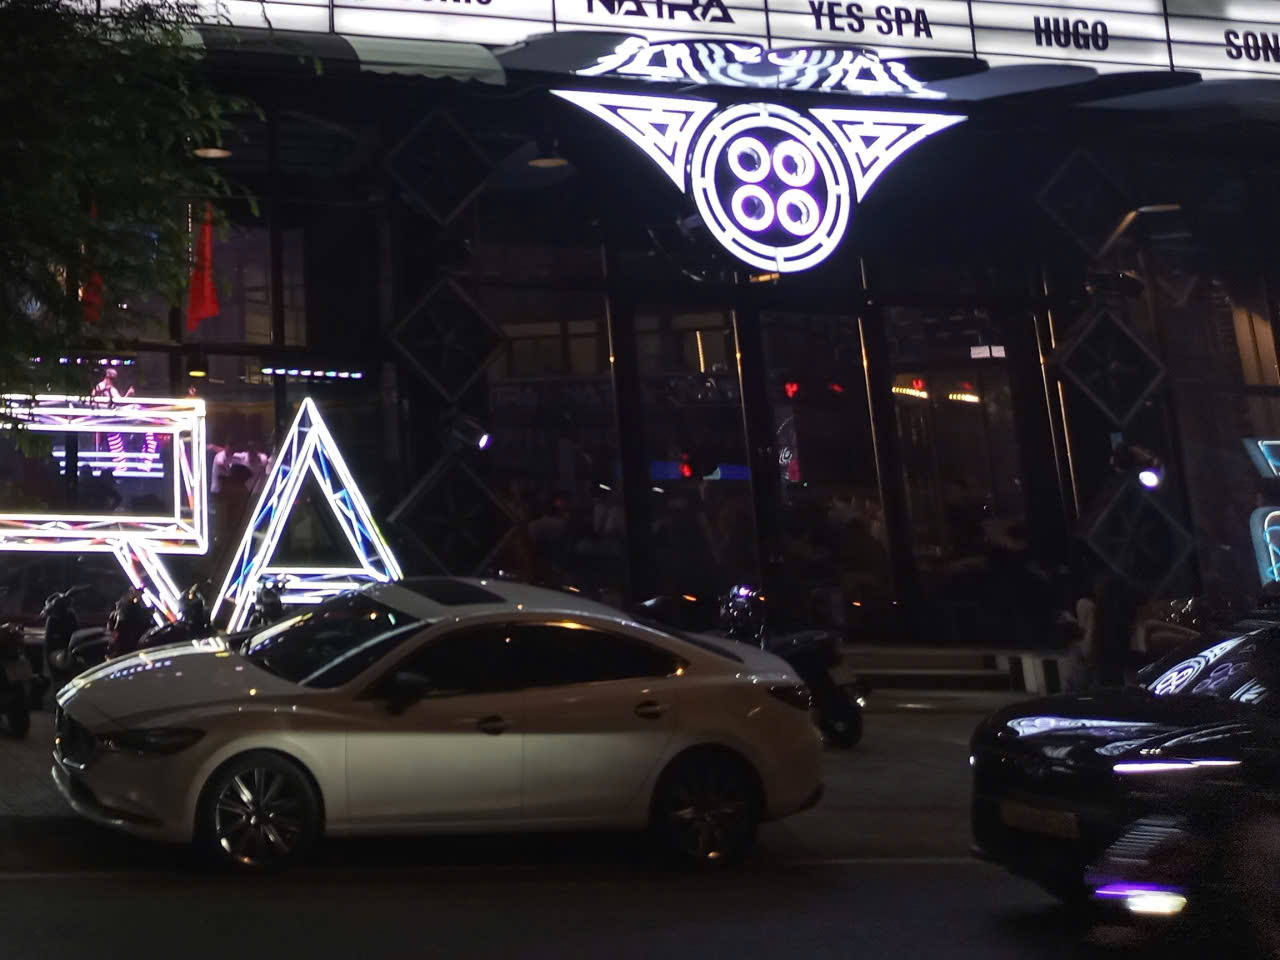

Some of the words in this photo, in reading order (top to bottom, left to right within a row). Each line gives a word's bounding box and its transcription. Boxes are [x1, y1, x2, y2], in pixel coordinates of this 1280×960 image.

[808, 0, 867, 35] YES
[875, 6, 933, 39] SPA
[1033, 16, 1108, 51] HUGO
